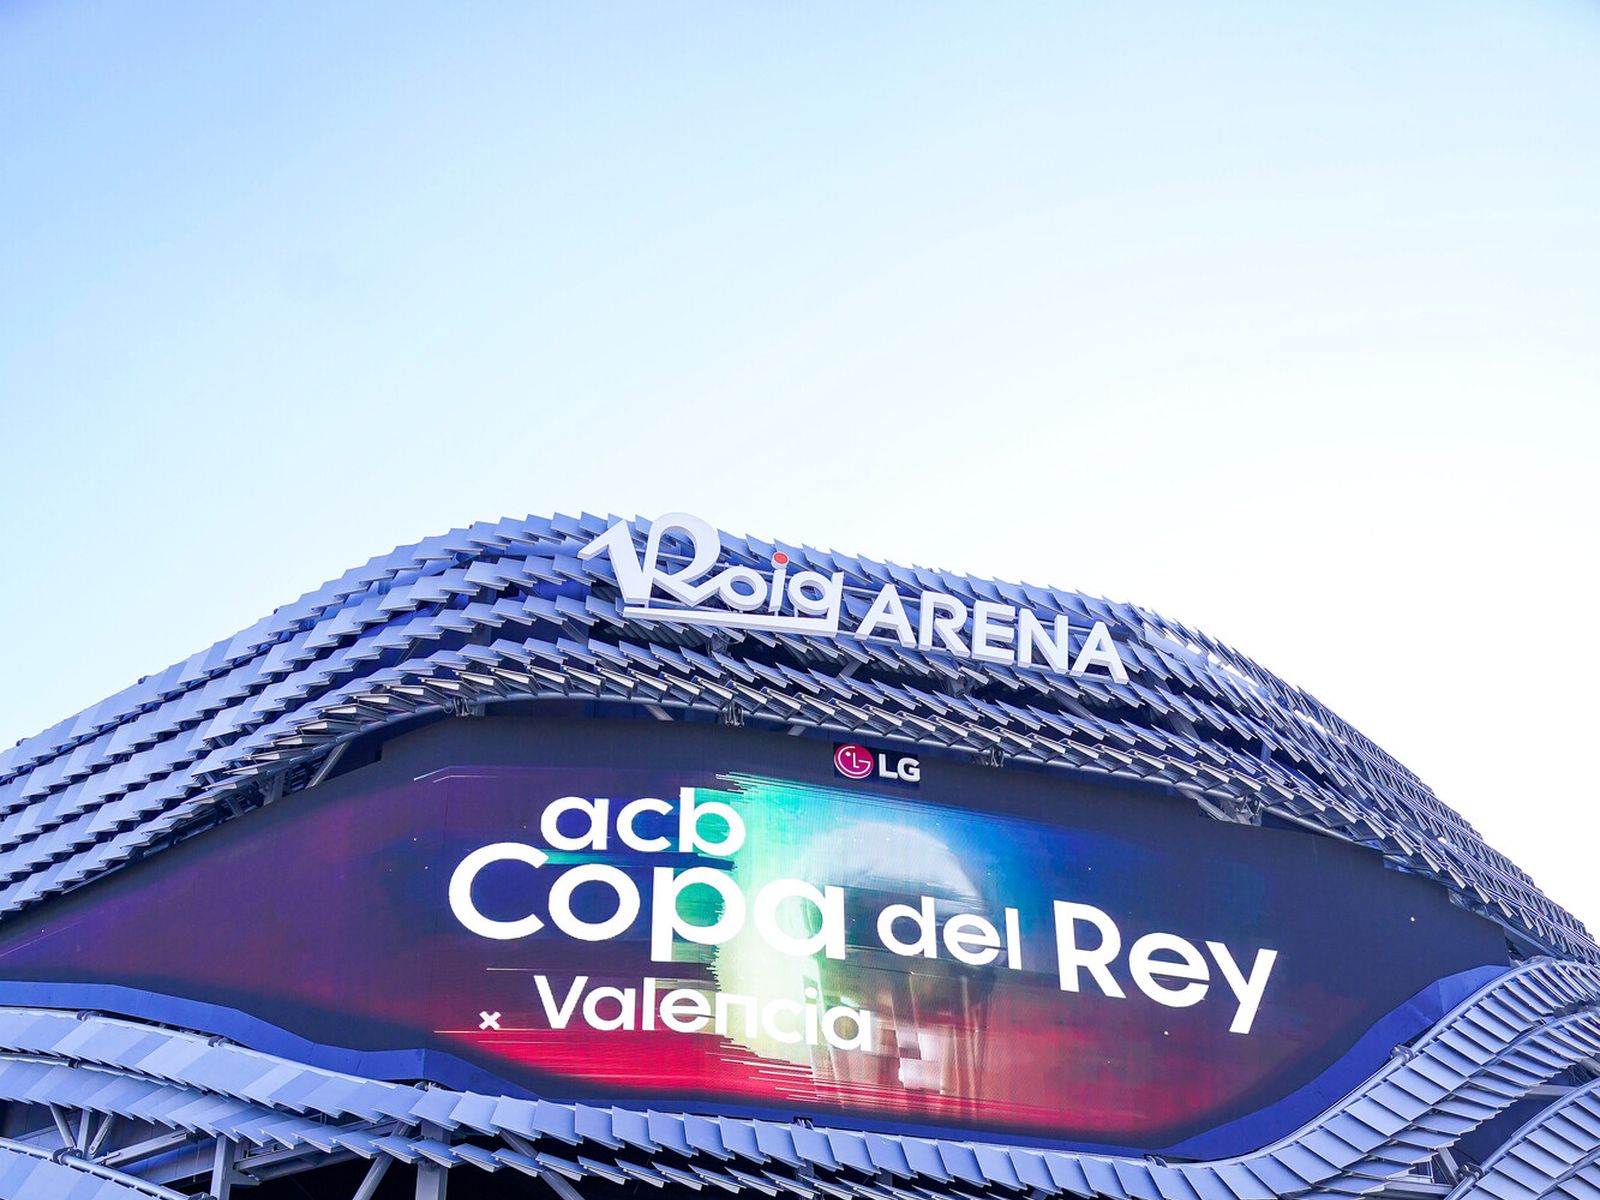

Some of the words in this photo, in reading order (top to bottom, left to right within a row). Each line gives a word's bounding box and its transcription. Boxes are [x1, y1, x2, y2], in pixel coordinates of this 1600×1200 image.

[577, 511, 845, 637] Roig
[854, 583, 1130, 684] ARENA
[879, 753, 921, 782] LG
[540, 786, 746, 856] acb
[448, 842, 846, 962] Copa
[876, 896, 1022, 970] del
[1053, 900, 1278, 1034] Rey
[534, 975, 872, 1051] Valencia
